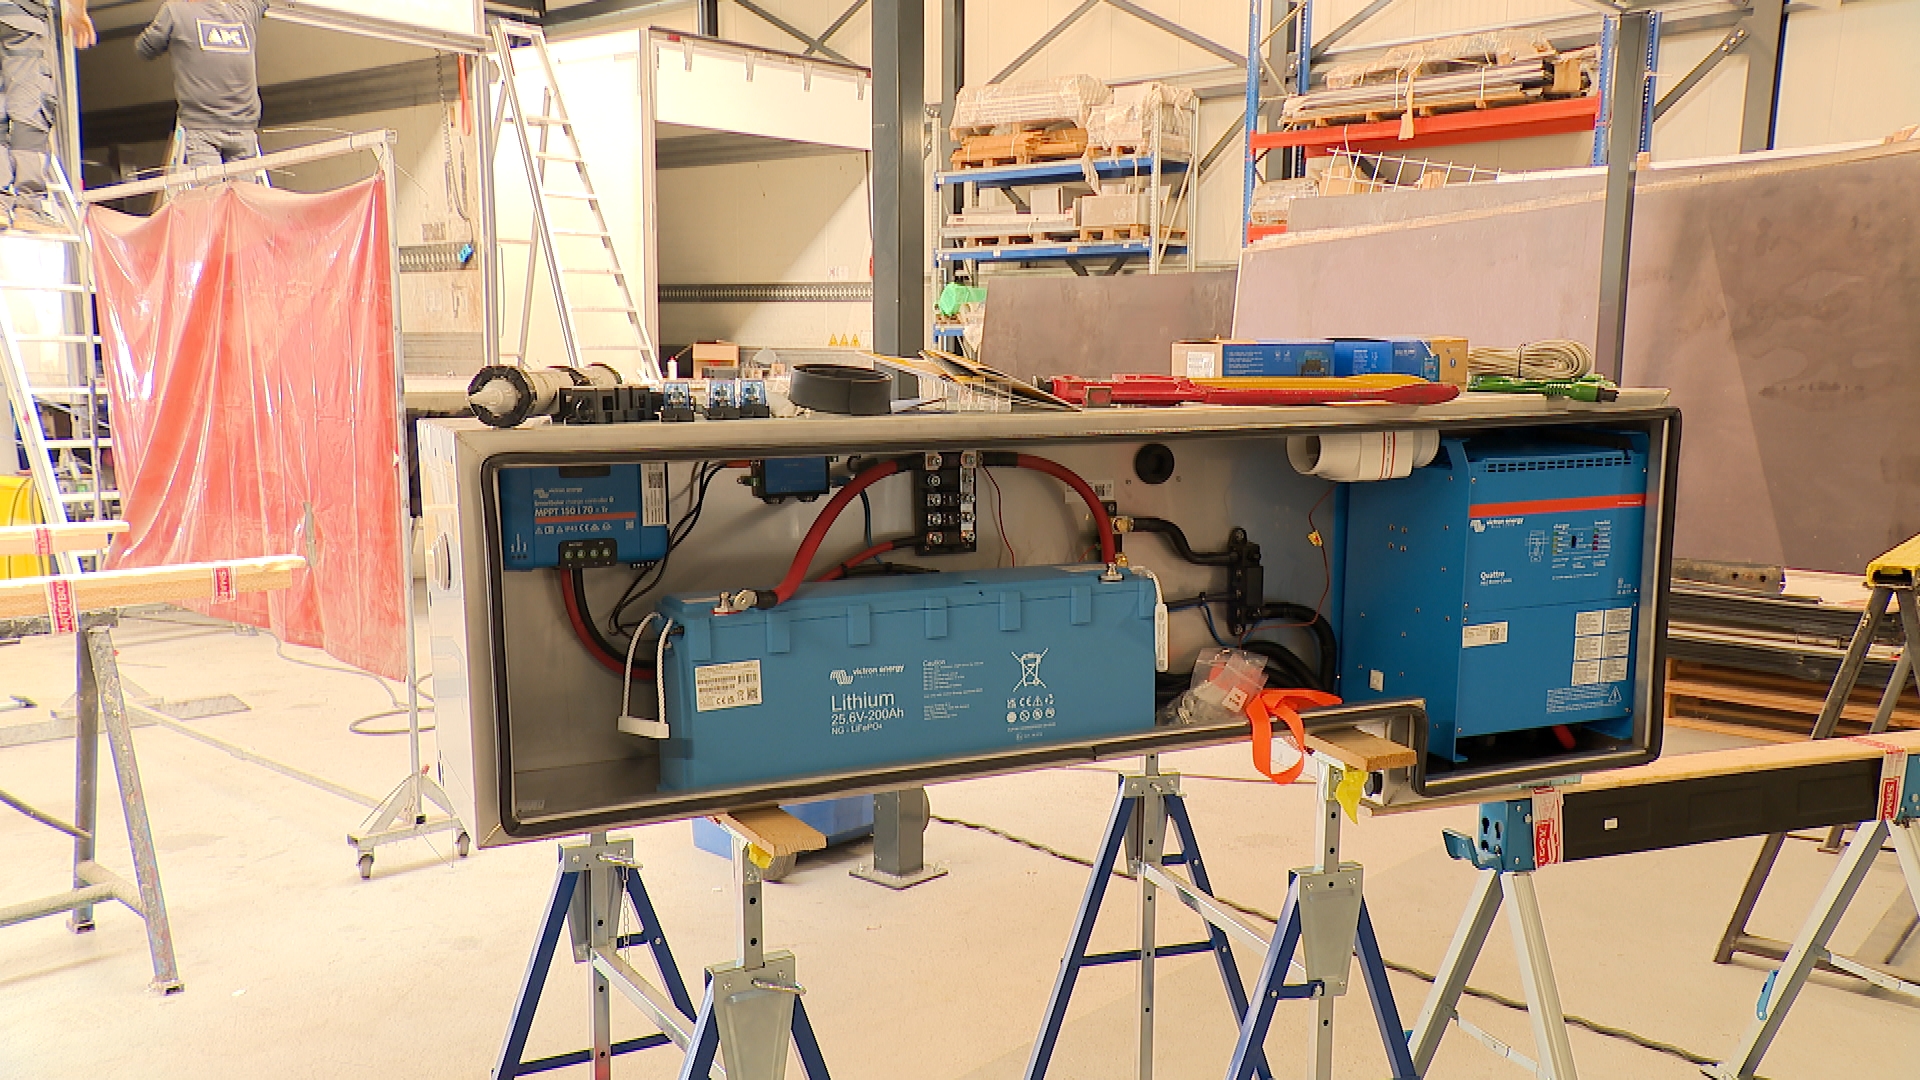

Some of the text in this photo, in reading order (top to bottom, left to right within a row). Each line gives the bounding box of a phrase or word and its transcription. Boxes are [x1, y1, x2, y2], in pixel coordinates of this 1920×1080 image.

[534, 507, 559, 517] MPPT
[582, 505, 594, 515] 70
[922, 659, 946, 668] Caution
[852, 664, 905, 676] victron energy
[831, 691, 896, 713] Lithium
[831, 706, 905, 727] 25.6V-200Ah
[831, 726, 845, 736] NG
